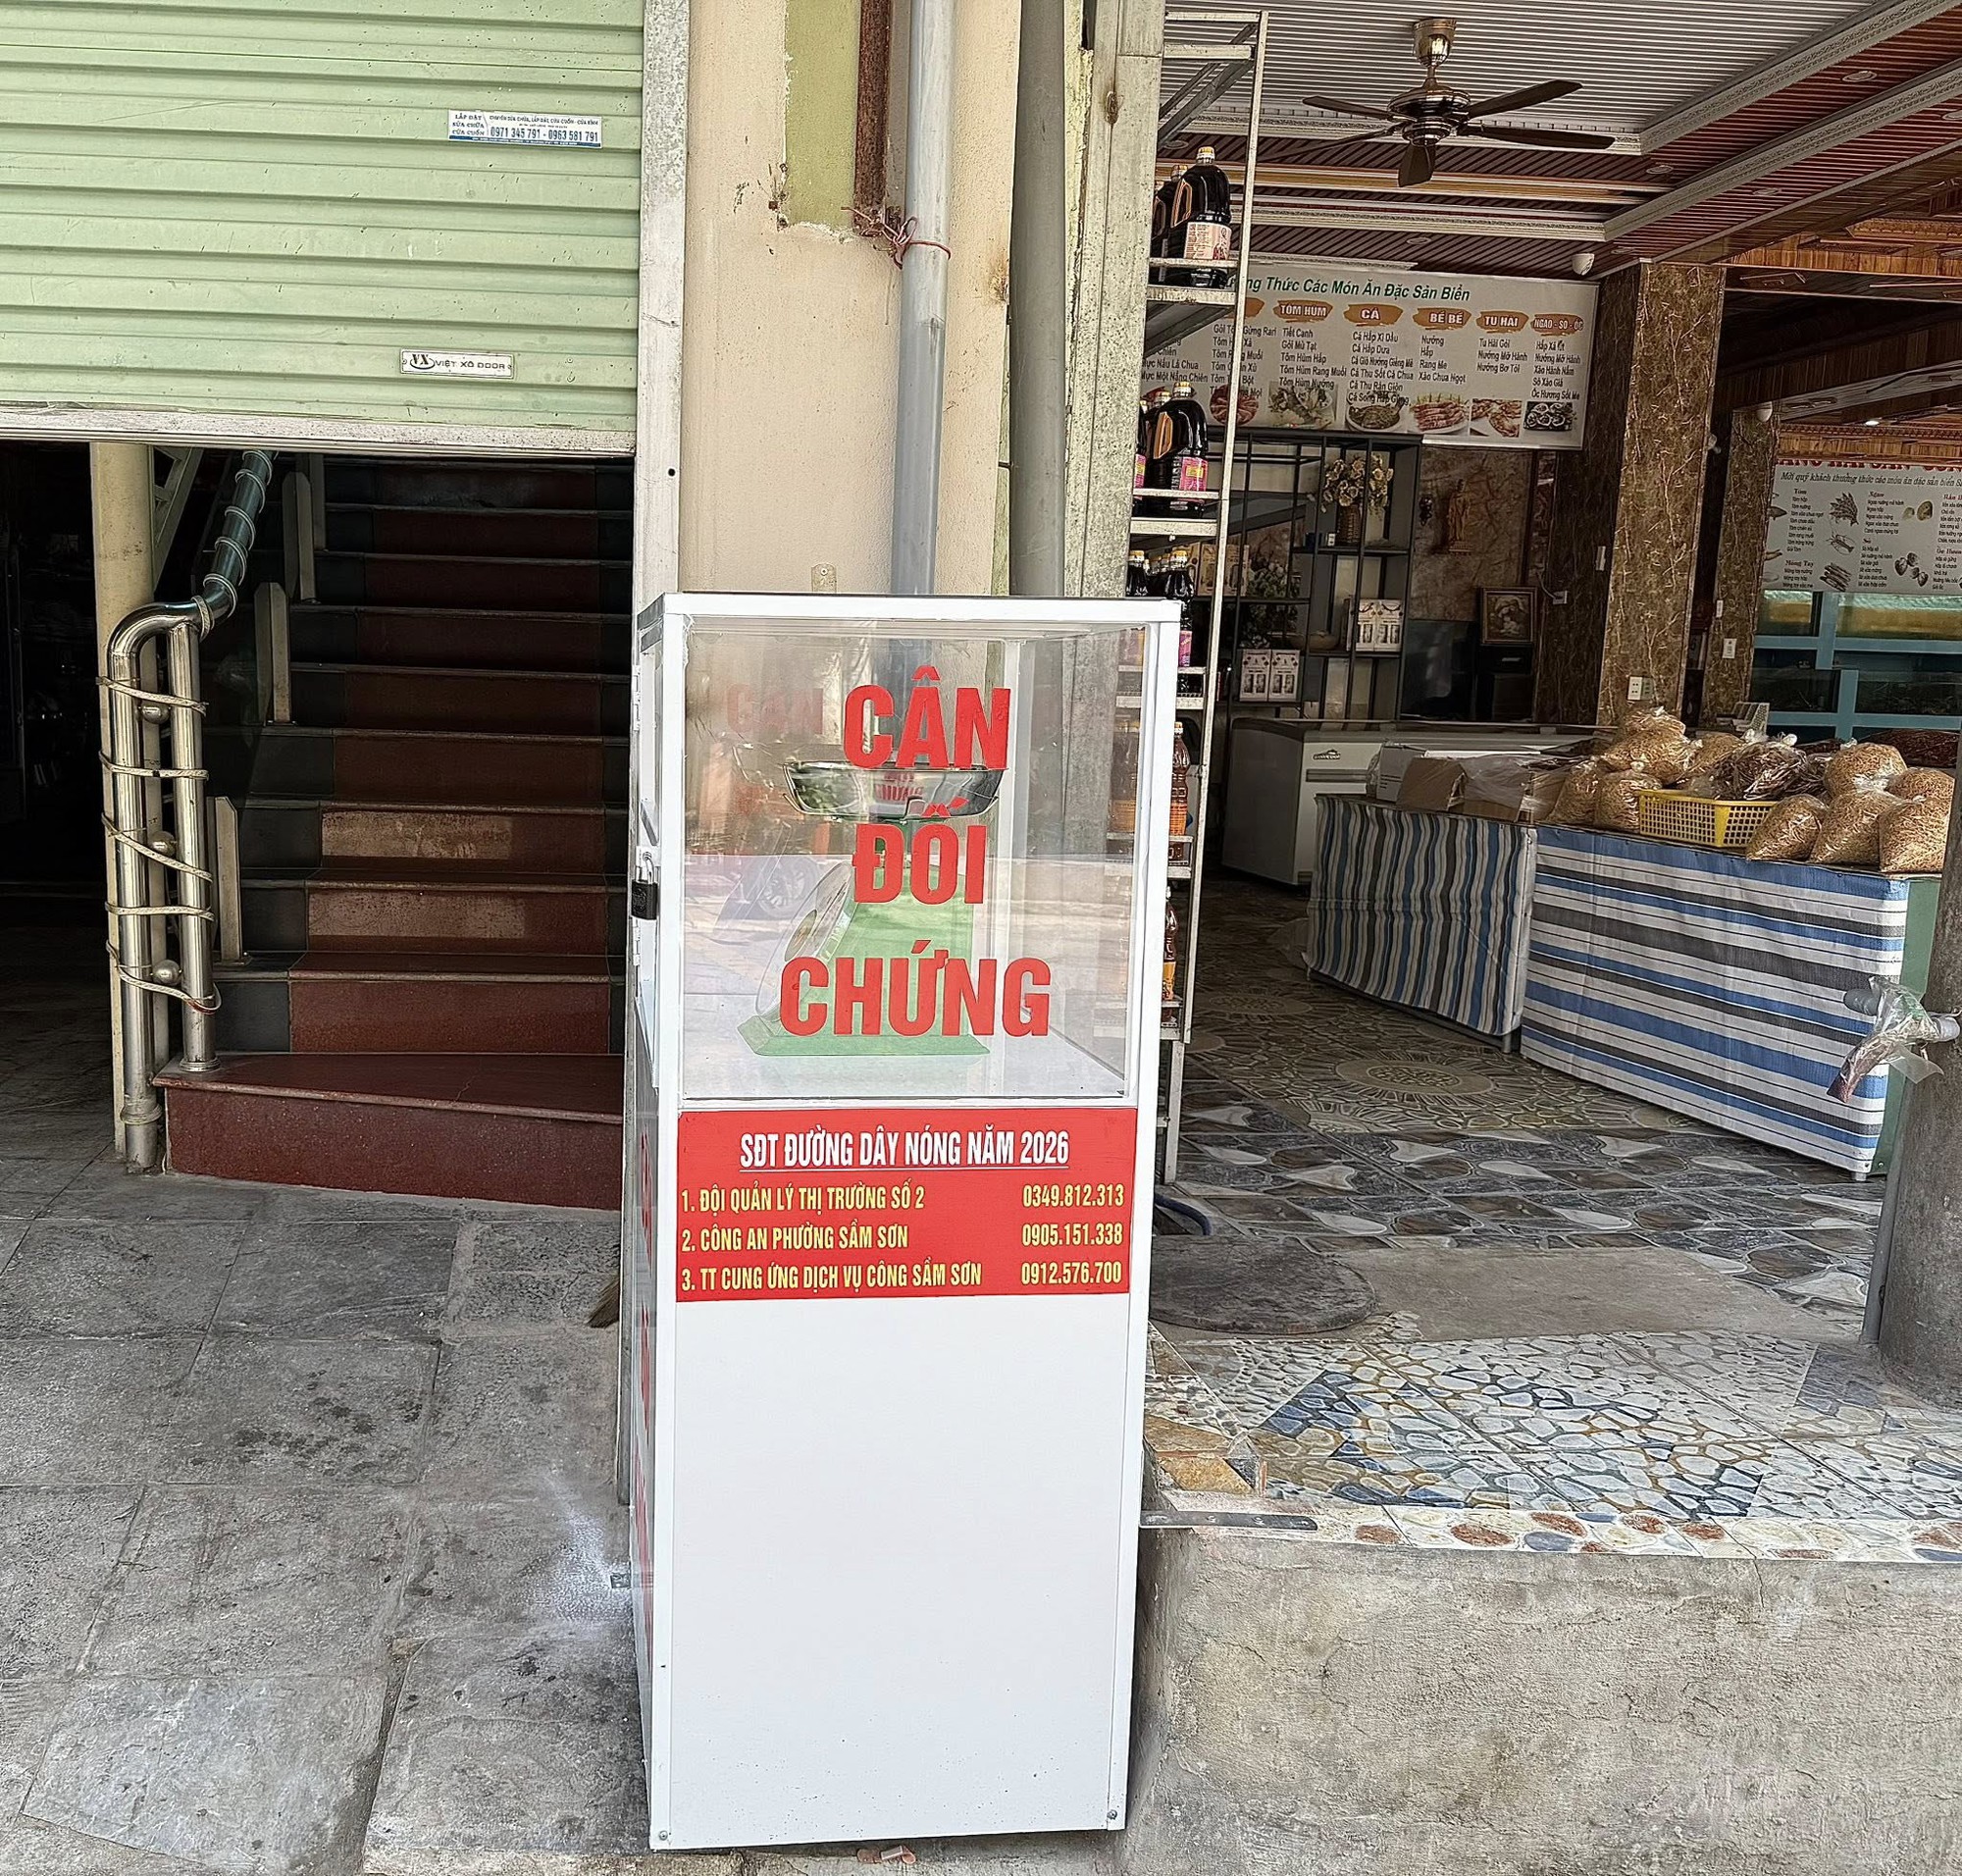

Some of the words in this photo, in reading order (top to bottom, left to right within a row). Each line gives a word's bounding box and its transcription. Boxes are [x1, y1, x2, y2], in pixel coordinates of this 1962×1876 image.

[490, 127, 508, 136] 0971
[511, 128, 525, 138] 345
[528, 129, 540, 138] 791
[548, 130, 566, 139] 0963
[569, 131, 582, 140] 581
[586, 131, 597, 141] 791
[1266, 277, 1300, 291] Thức
[1304, 278, 1328, 293] Các
[1332, 280, 1359, 295] Món
[1363, 278, 1380, 296] Ăn
[1384, 284, 1410, 300] Đặc
[1413, 285, 1437, 299] Sản
[1442, 284, 1471, 300] Biển
[1296, 329, 1313, 338] Canh
[1281, 352, 1295, 362] Tôm
[1181, 360, 1199, 369] Chua
[1280, 365, 1294, 374] Tôm
[1313, 366, 1329, 378] Rang
[1420, 360, 1436, 370] Rang
[1189, 373, 1208, 383] Chiên
[1397, 371, 1414, 380] Chua
[1433, 373, 1449, 382] Chua
[844, 664, 1011, 770] CÂN
[852, 797, 987, 905] ĐỐI
[780, 940, 1052, 1037] CHỨNG
[740, 1133, 779, 1168] SĐT
[784, 1124, 853, 1167] ĐƯỜNG
[859, 1124, 900, 1166] DÂY
[904, 1124, 961, 1166] NÓNG
[966, 1123, 1014, 1165] NĂM
[1019, 1130, 1069, 1165] 2026
[681, 1189, 696, 1212] 1.
[698, 1183, 725, 1217] ĐỘI
[730, 1180, 772, 1214] QUẢN
[776, 1182, 795, 1211] LÝ
[798, 1187, 822, 1216] THỊ
[826, 1180, 887, 1210] TRƯỜNG
[891, 1177, 911, 1209] SỐ
[914, 1185, 924, 1209] 2
[1023, 1183, 1124, 1207] 0349.812.313
[682, 1228, 696, 1252] 2.
[700, 1223, 742, 1252] CÔNG
[746, 1227, 768, 1250] AN
[772, 1221, 834, 1250] PHƯỜNG
[839, 1218, 872, 1249] SẦM
[877, 1224, 908, 1248] SƠN
[1022, 1223, 1123, 1246] 0905.151.338
[682, 1268, 696, 1291] 3.
[699, 1267, 717, 1290] TT
[721, 1266, 763, 1290] CUNG
[767, 1262, 799, 1289] ỨNG
[802, 1266, 839, 1293] DỊCH
[843, 1265, 862, 1293] VỤ
[866, 1260, 907, 1287] CÔNG
[912, 1256, 946, 1286] SẦM
[950, 1261, 982, 1286] SƠN
[1021, 1261, 1122, 1285] 0912.576.700
